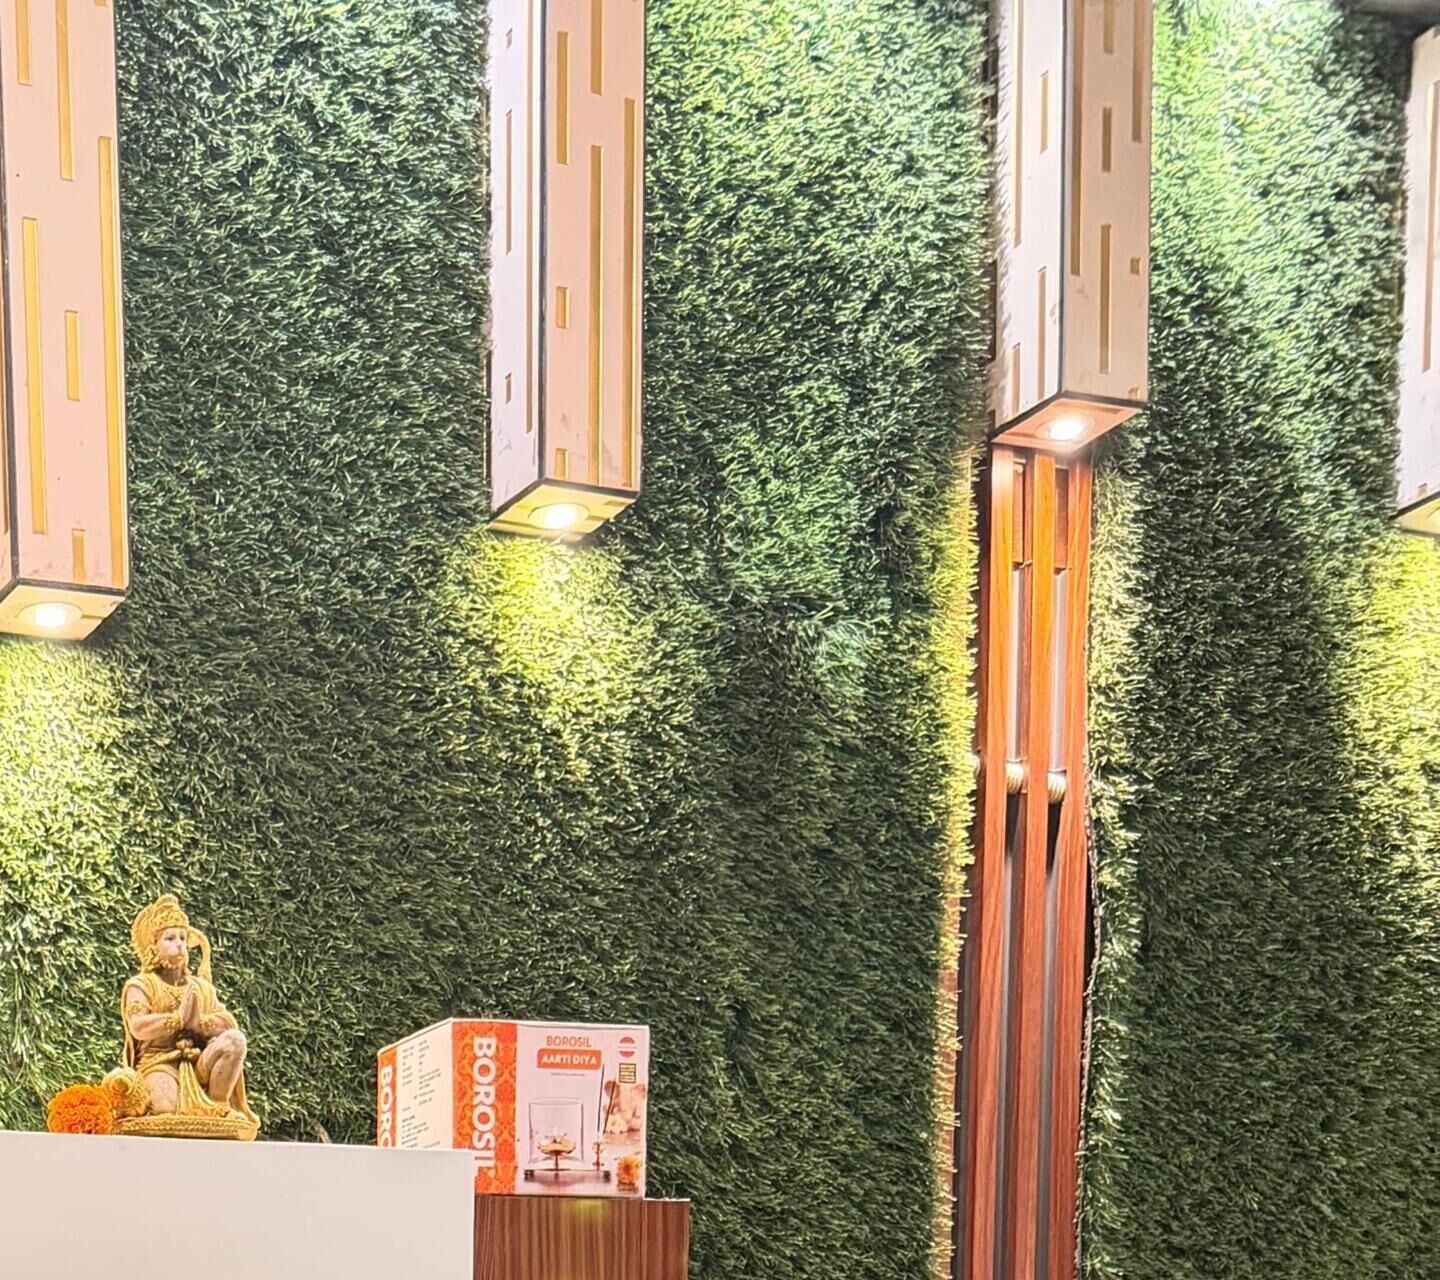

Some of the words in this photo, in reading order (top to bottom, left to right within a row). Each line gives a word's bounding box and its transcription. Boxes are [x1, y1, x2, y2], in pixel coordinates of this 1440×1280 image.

[546, 1035, 592, 1048] BOROSIL
[541, 1054, 571, 1064] AARTI
[573, 1055, 597, 1065] DIYA
